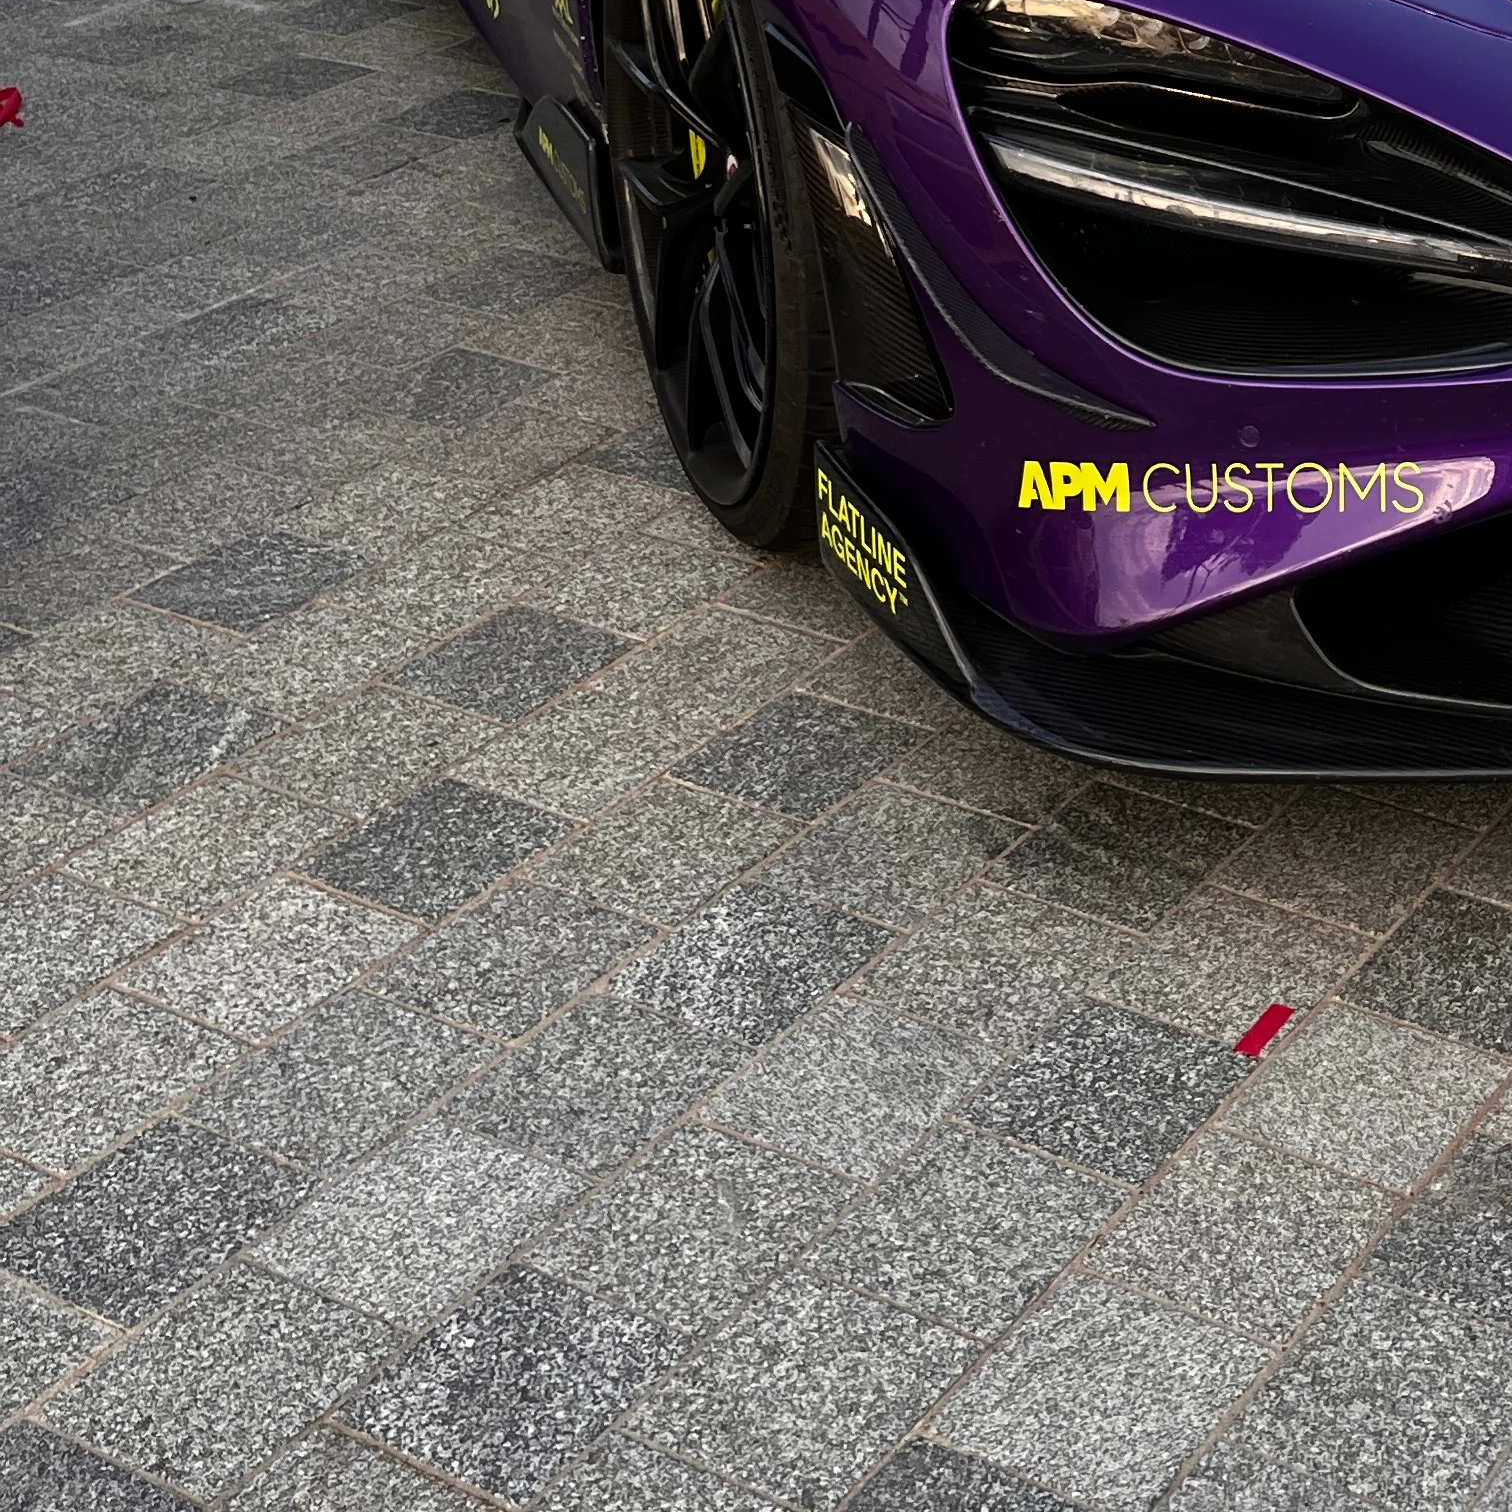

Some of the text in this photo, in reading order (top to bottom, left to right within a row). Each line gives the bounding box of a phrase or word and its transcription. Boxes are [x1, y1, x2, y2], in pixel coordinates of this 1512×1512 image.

[817, 467, 907, 589] FLATLINE
[1018, 461, 1425, 514] APM CUSTOMS
